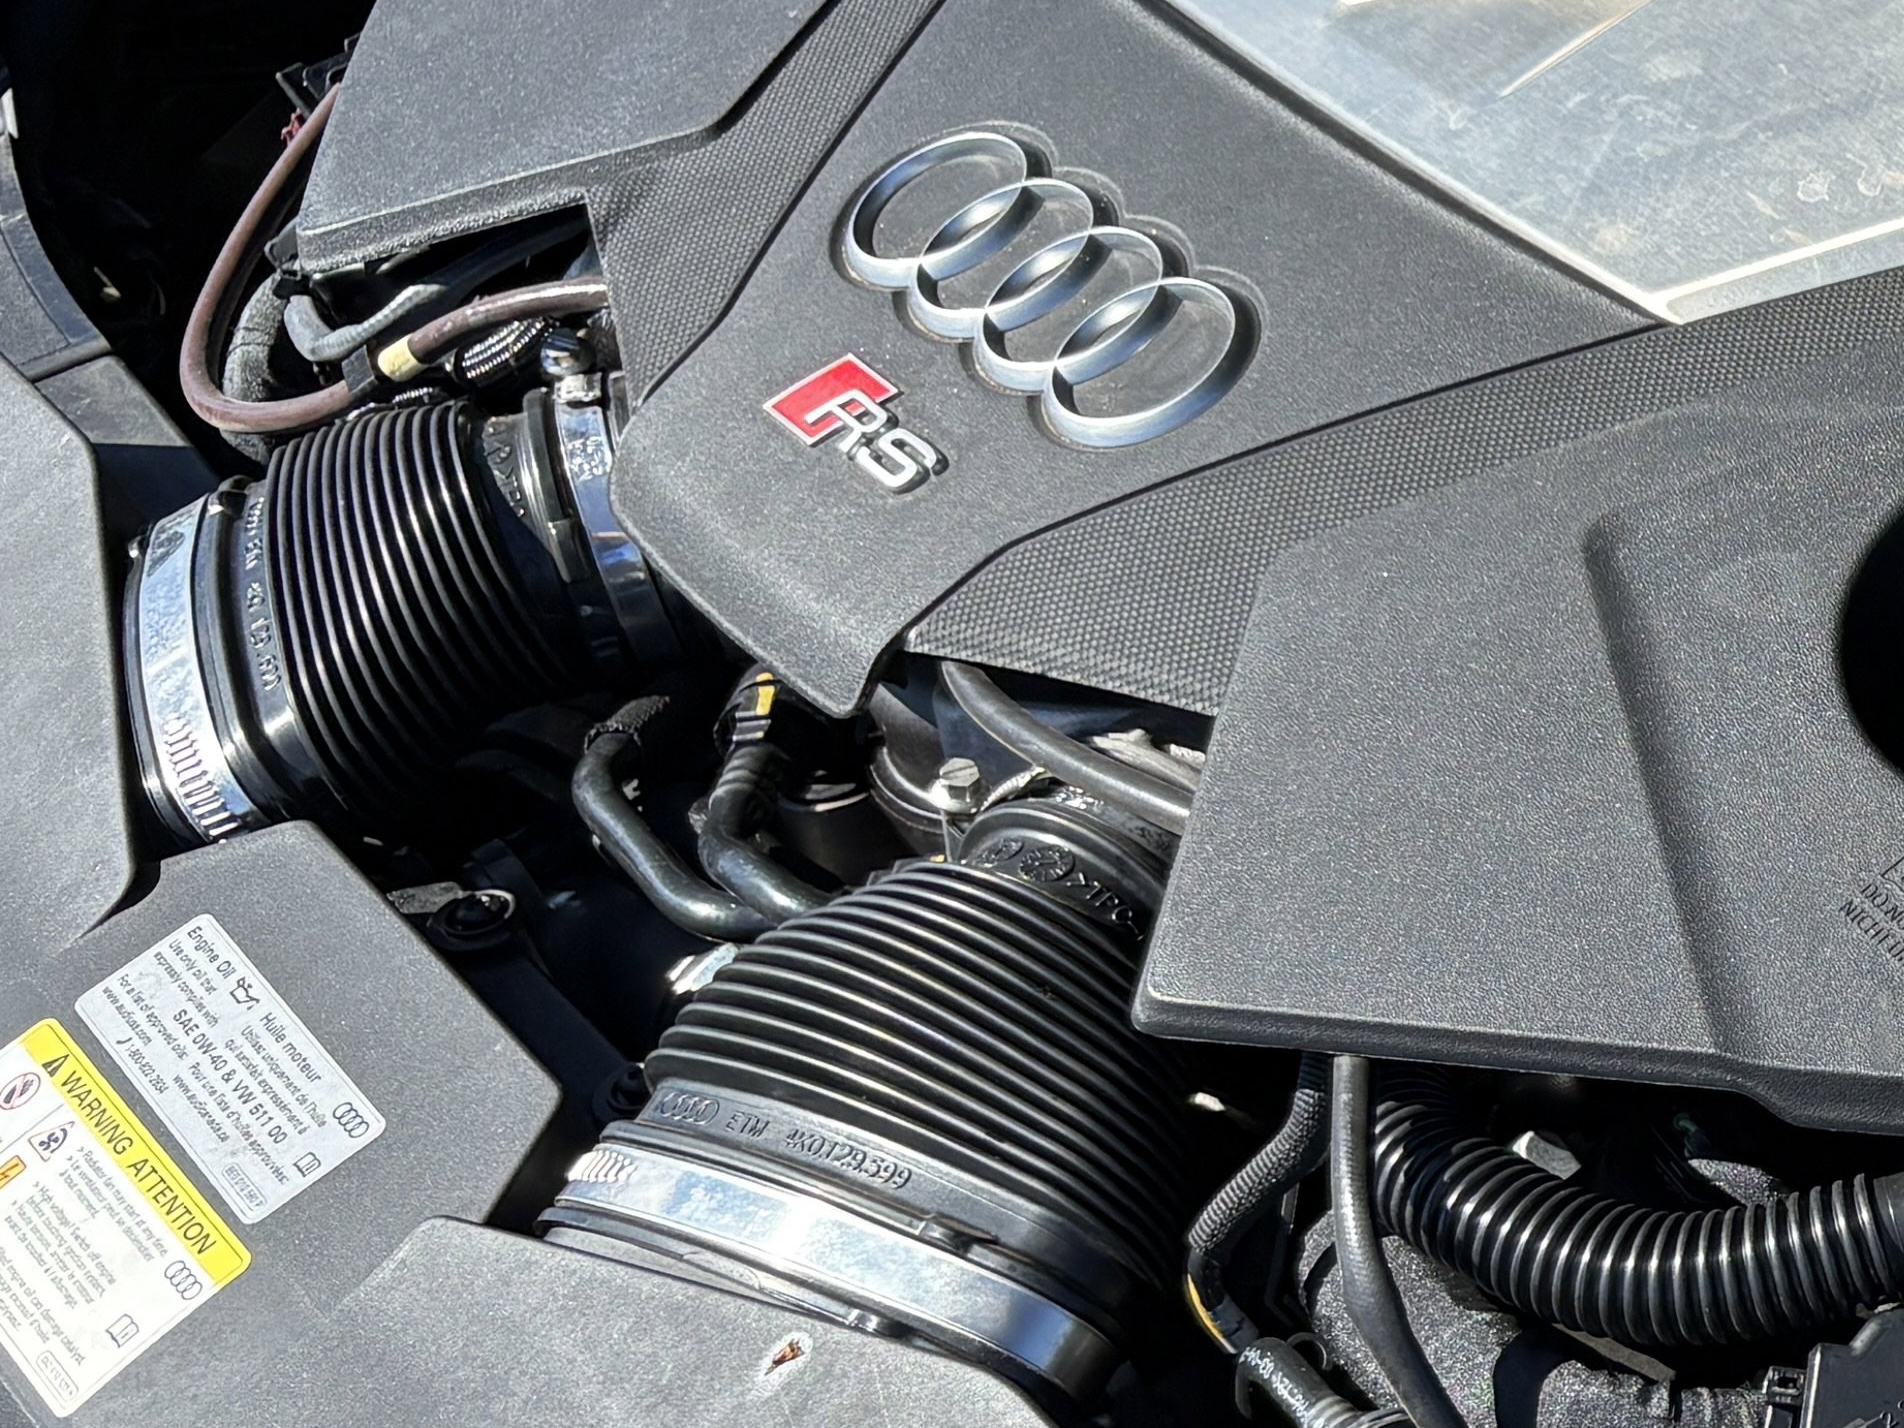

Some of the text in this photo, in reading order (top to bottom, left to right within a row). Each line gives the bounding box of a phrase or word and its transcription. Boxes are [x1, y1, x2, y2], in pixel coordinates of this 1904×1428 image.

[800, 386, 941, 490] RS
[187, 926, 237, 980] Engine Oil
[168, 939, 218, 996] Use only oil that
[117, 973, 132, 989] For
[125, 987, 136, 996] a
[131, 990, 146, 1006] list
[139, 1003, 155, 1012] of
[146, 1011, 178, 1046] approved
[201, 1010, 220, 1028] with
[224, 1038, 243, 1054] qui
[259, 1012, 322, 1082] Huile moteur
[173, 1009, 288, 1144] SAE 0W-40 & VW 511 00
[188, 1061, 207, 1083] Pour
[295, 1093, 309, 1106] de
[725, 1110, 770, 1139] ETM
[61, 1070, 216, 1254] WARNING ATTENTION
